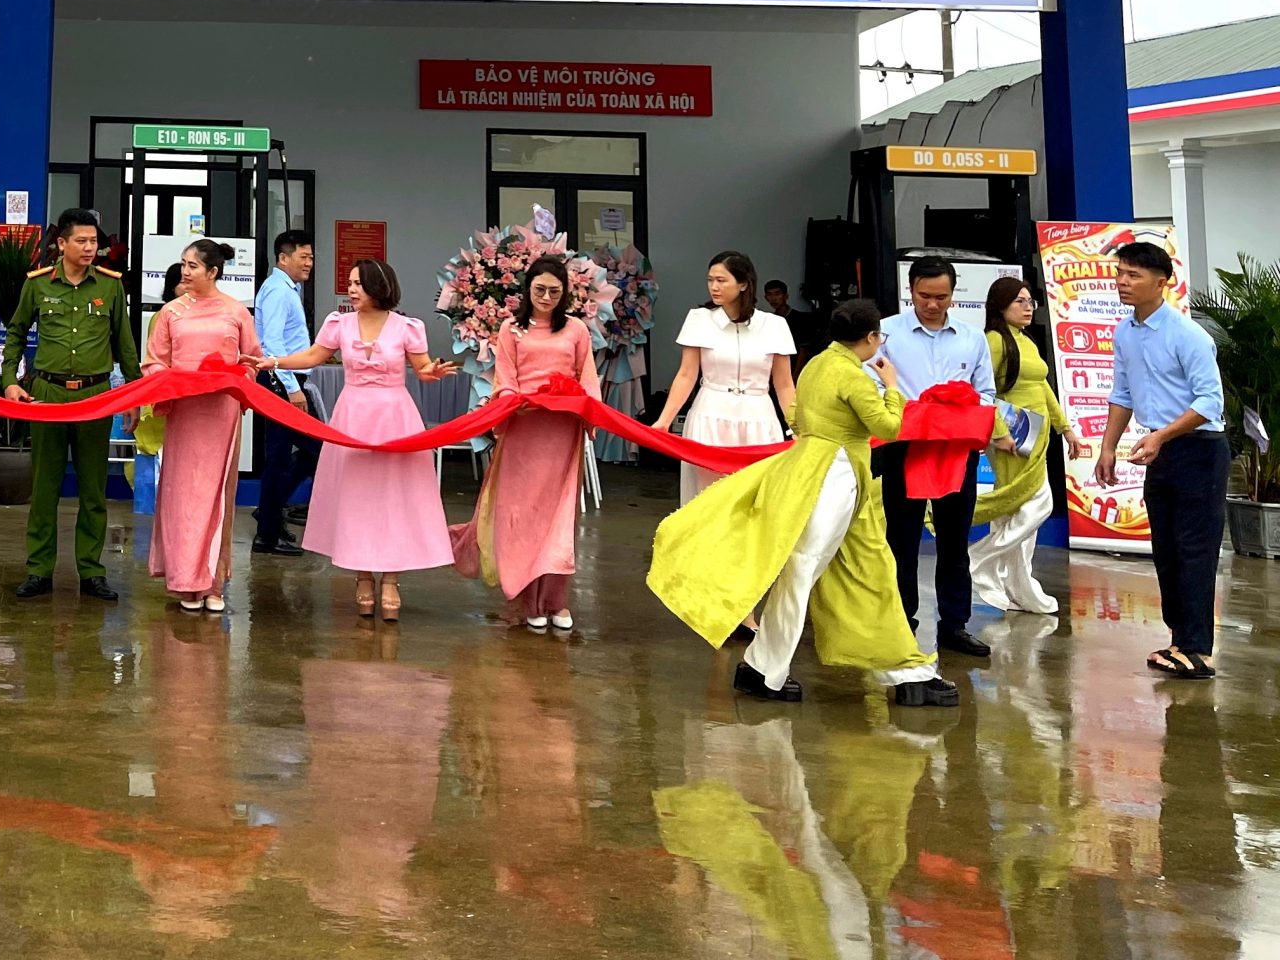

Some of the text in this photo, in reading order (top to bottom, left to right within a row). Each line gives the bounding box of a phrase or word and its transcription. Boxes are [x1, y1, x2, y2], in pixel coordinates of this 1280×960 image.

[475, 64, 655, 87] BẢO VỆ MÔI TRƯỜNG
[438, 87, 695, 112] LÀ TRÁCH NHIỆM CỦA TOÀN XÃ HỘI
[158, 130, 177, 144] E10
[188, 131, 210, 145] RON
[233, 132, 245, 146] III
[914, 151, 933, 166] DO
[942, 152, 984, 168] 0,05S
[999, 152, 1009, 168] II
[1054, 262, 1098, 281] KHAI
[1072, 281, 1107, 292] ƯU ĐÃI
